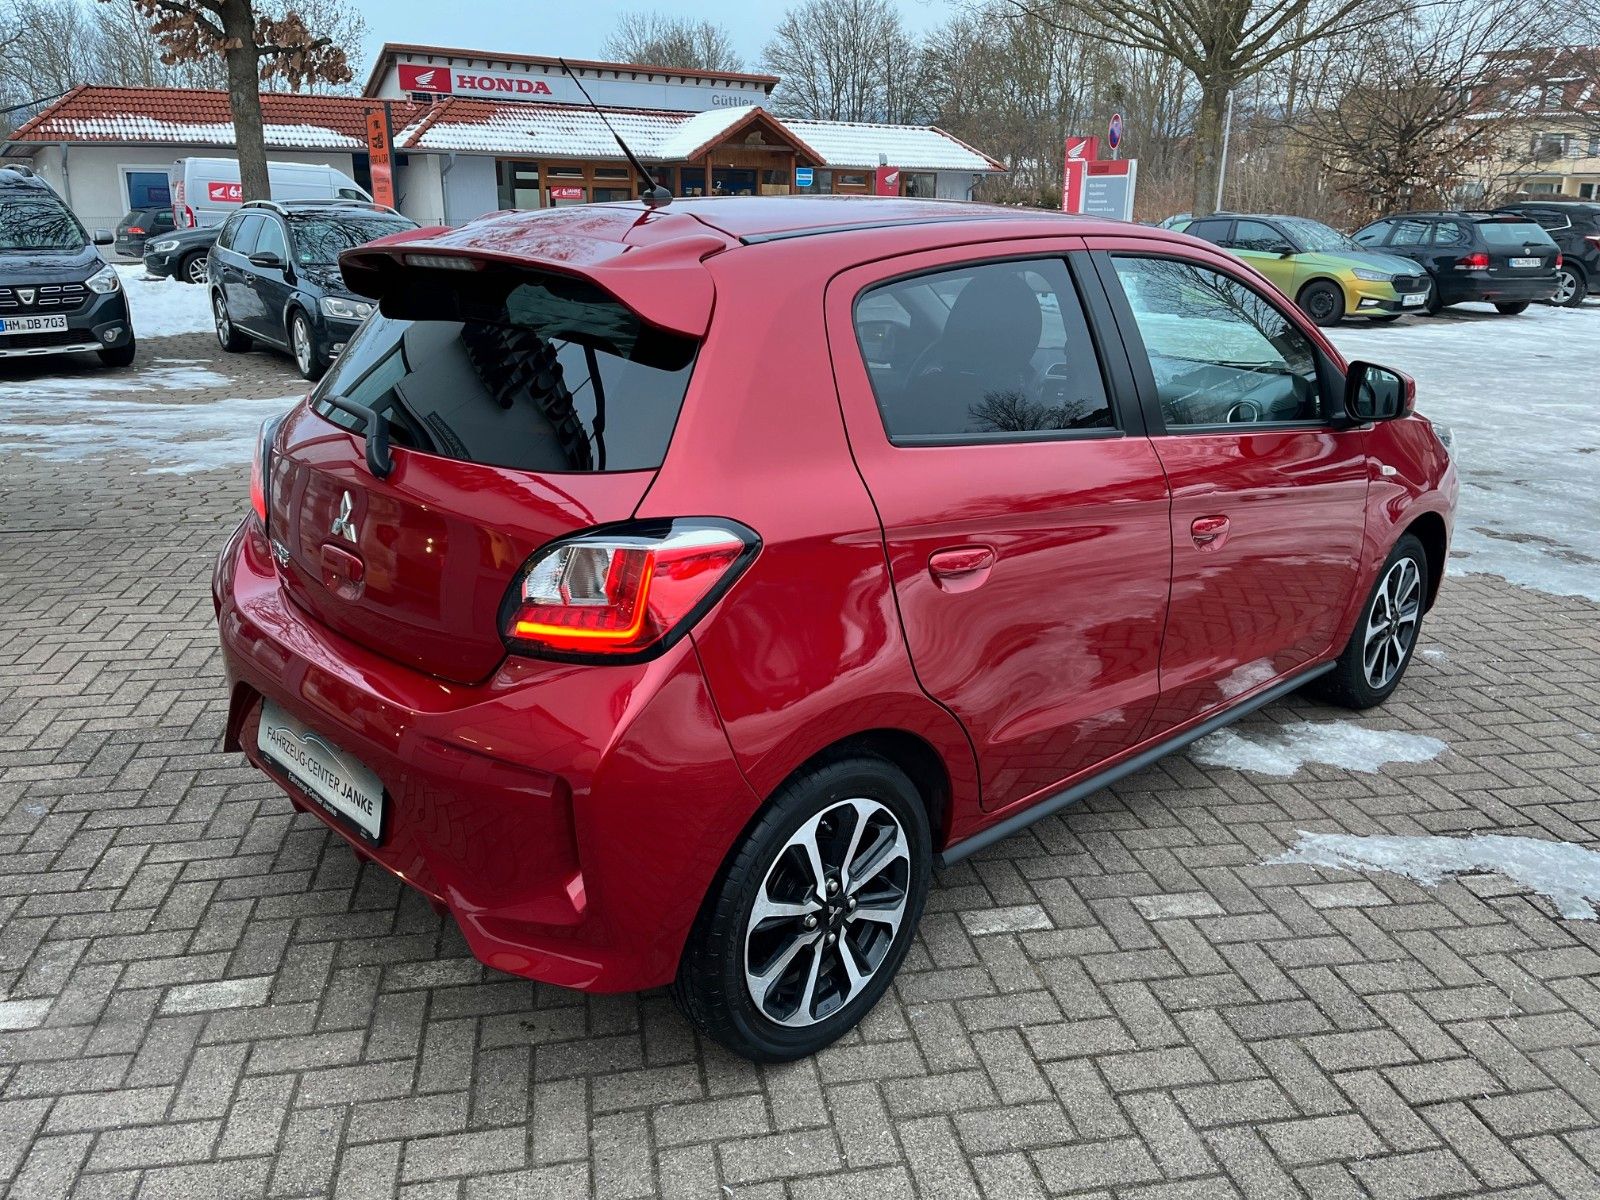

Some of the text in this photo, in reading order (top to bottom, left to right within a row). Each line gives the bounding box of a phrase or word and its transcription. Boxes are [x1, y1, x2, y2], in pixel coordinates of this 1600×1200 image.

[456, 75, 552, 95] HONDA
[711, 94, 755, 107] Güttler
[716, 181, 722, 189] 2
[5, 317, 65, 330] HM DB 703
[267, 726, 374, 817] FAHRZEUG-CENTER JANKE
